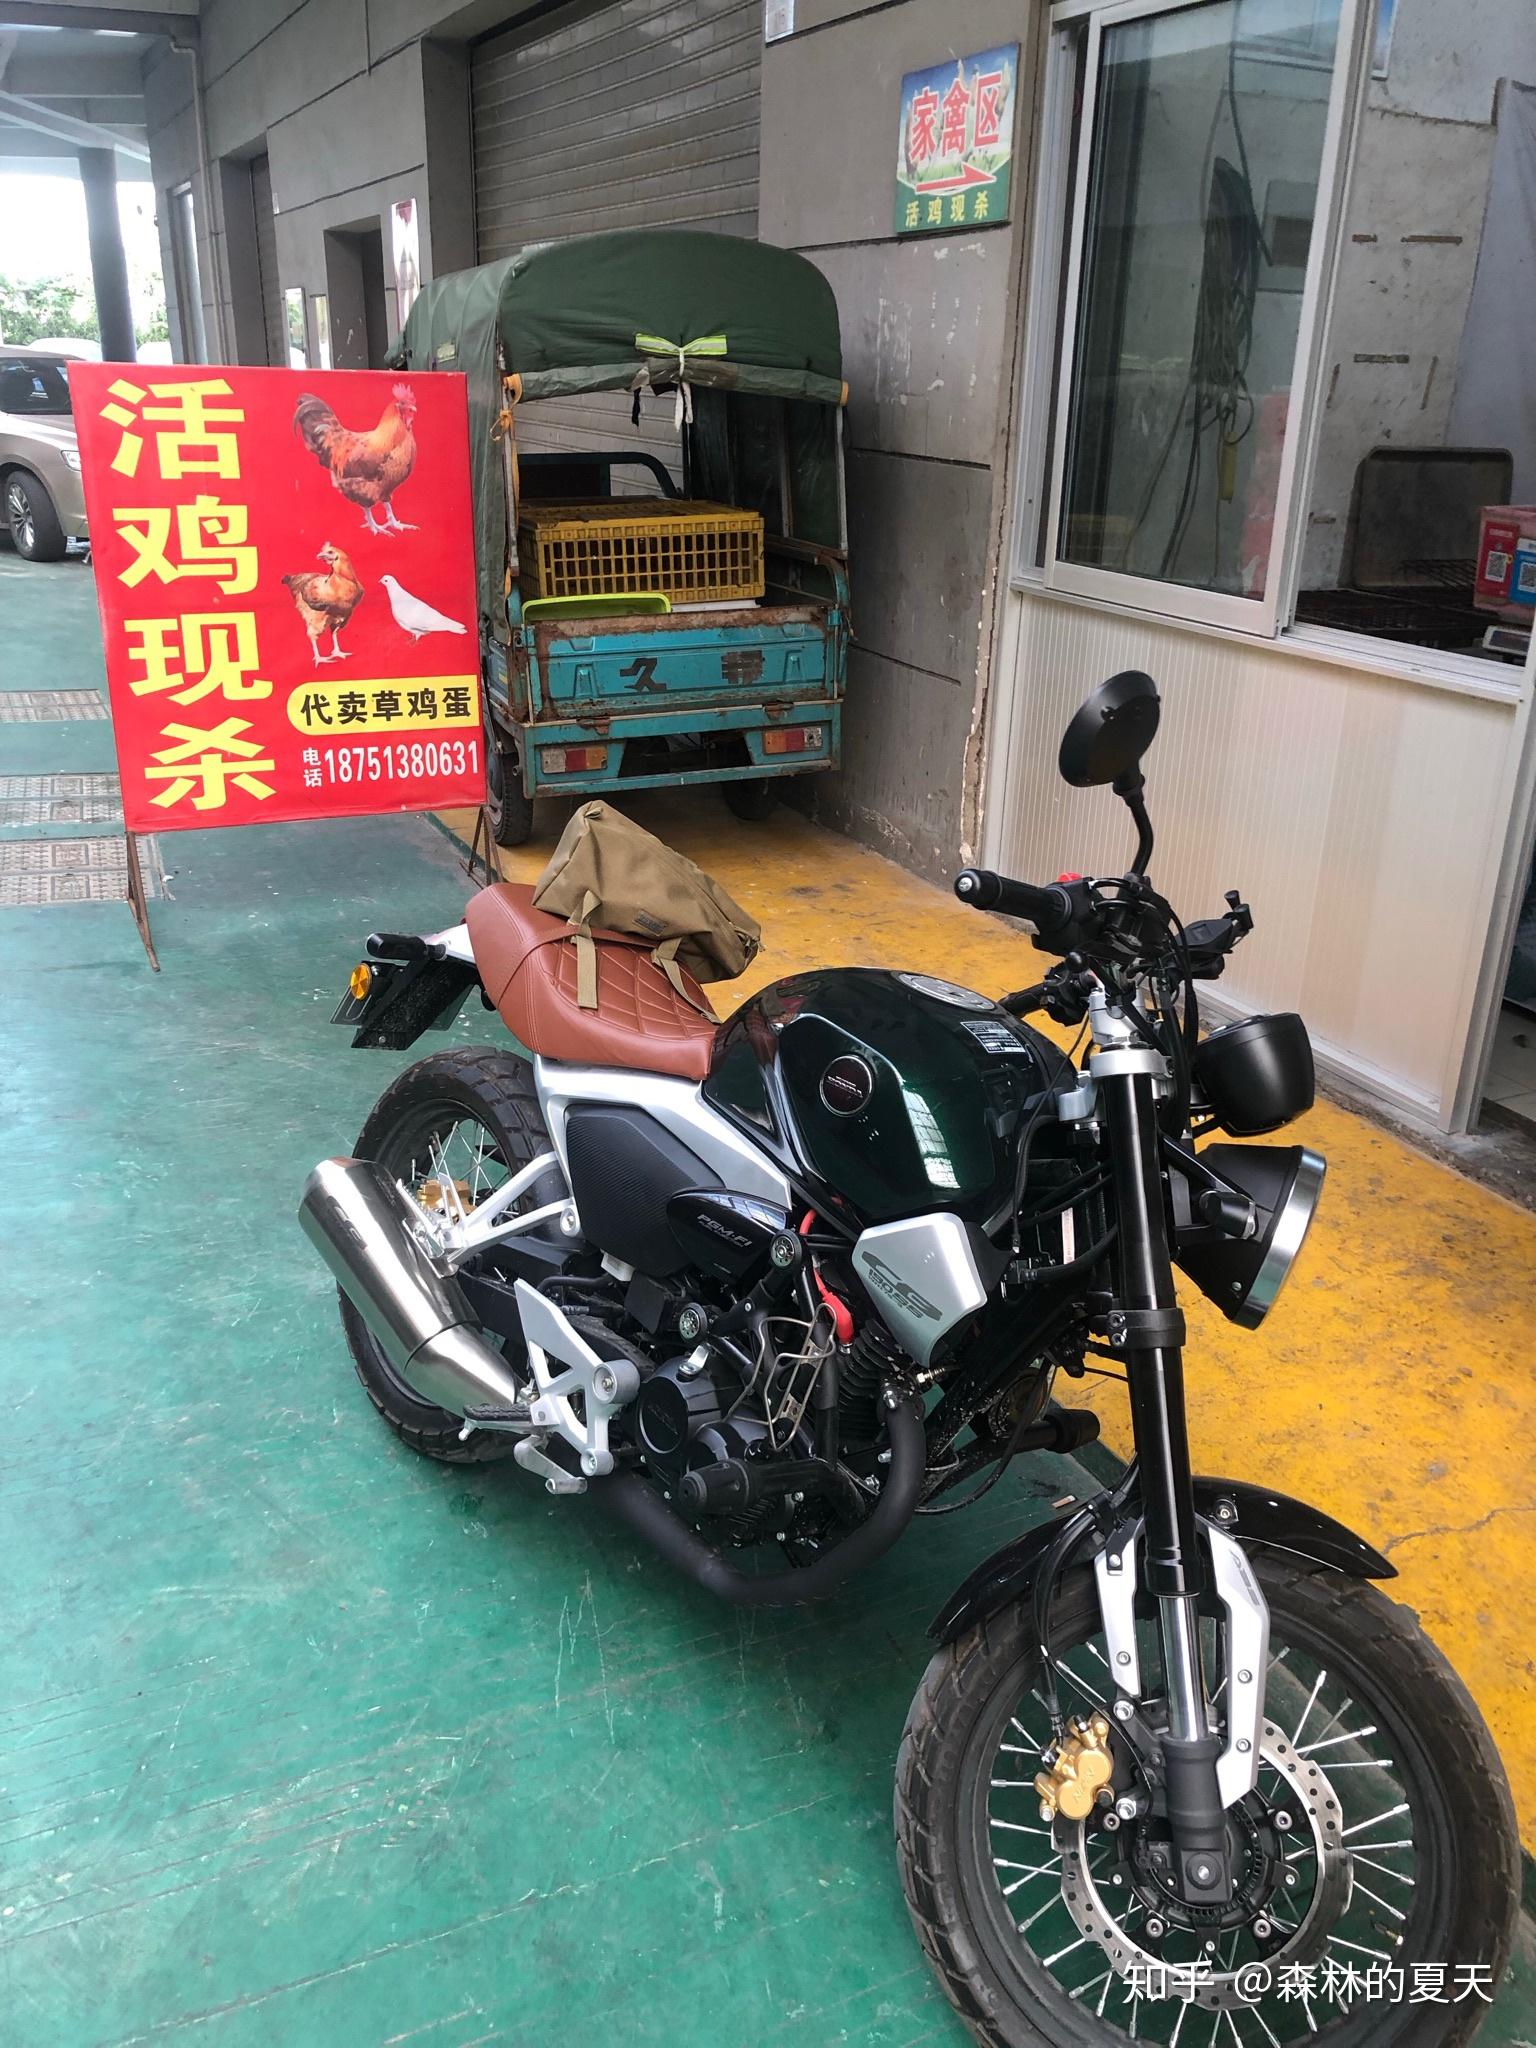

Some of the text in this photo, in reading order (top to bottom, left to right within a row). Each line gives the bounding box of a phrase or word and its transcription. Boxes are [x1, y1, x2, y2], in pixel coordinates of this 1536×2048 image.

[909, 72, 1002, 161] 家禽区
[906, 191, 988, 227] 活鸡现杀
[99, 379, 277, 810] 活鸡现杀
[300, 687, 472, 726] 代卖草鸡蛋
[303, 747, 323, 787] 电话
[324, 740, 478, 783] 18751380631
